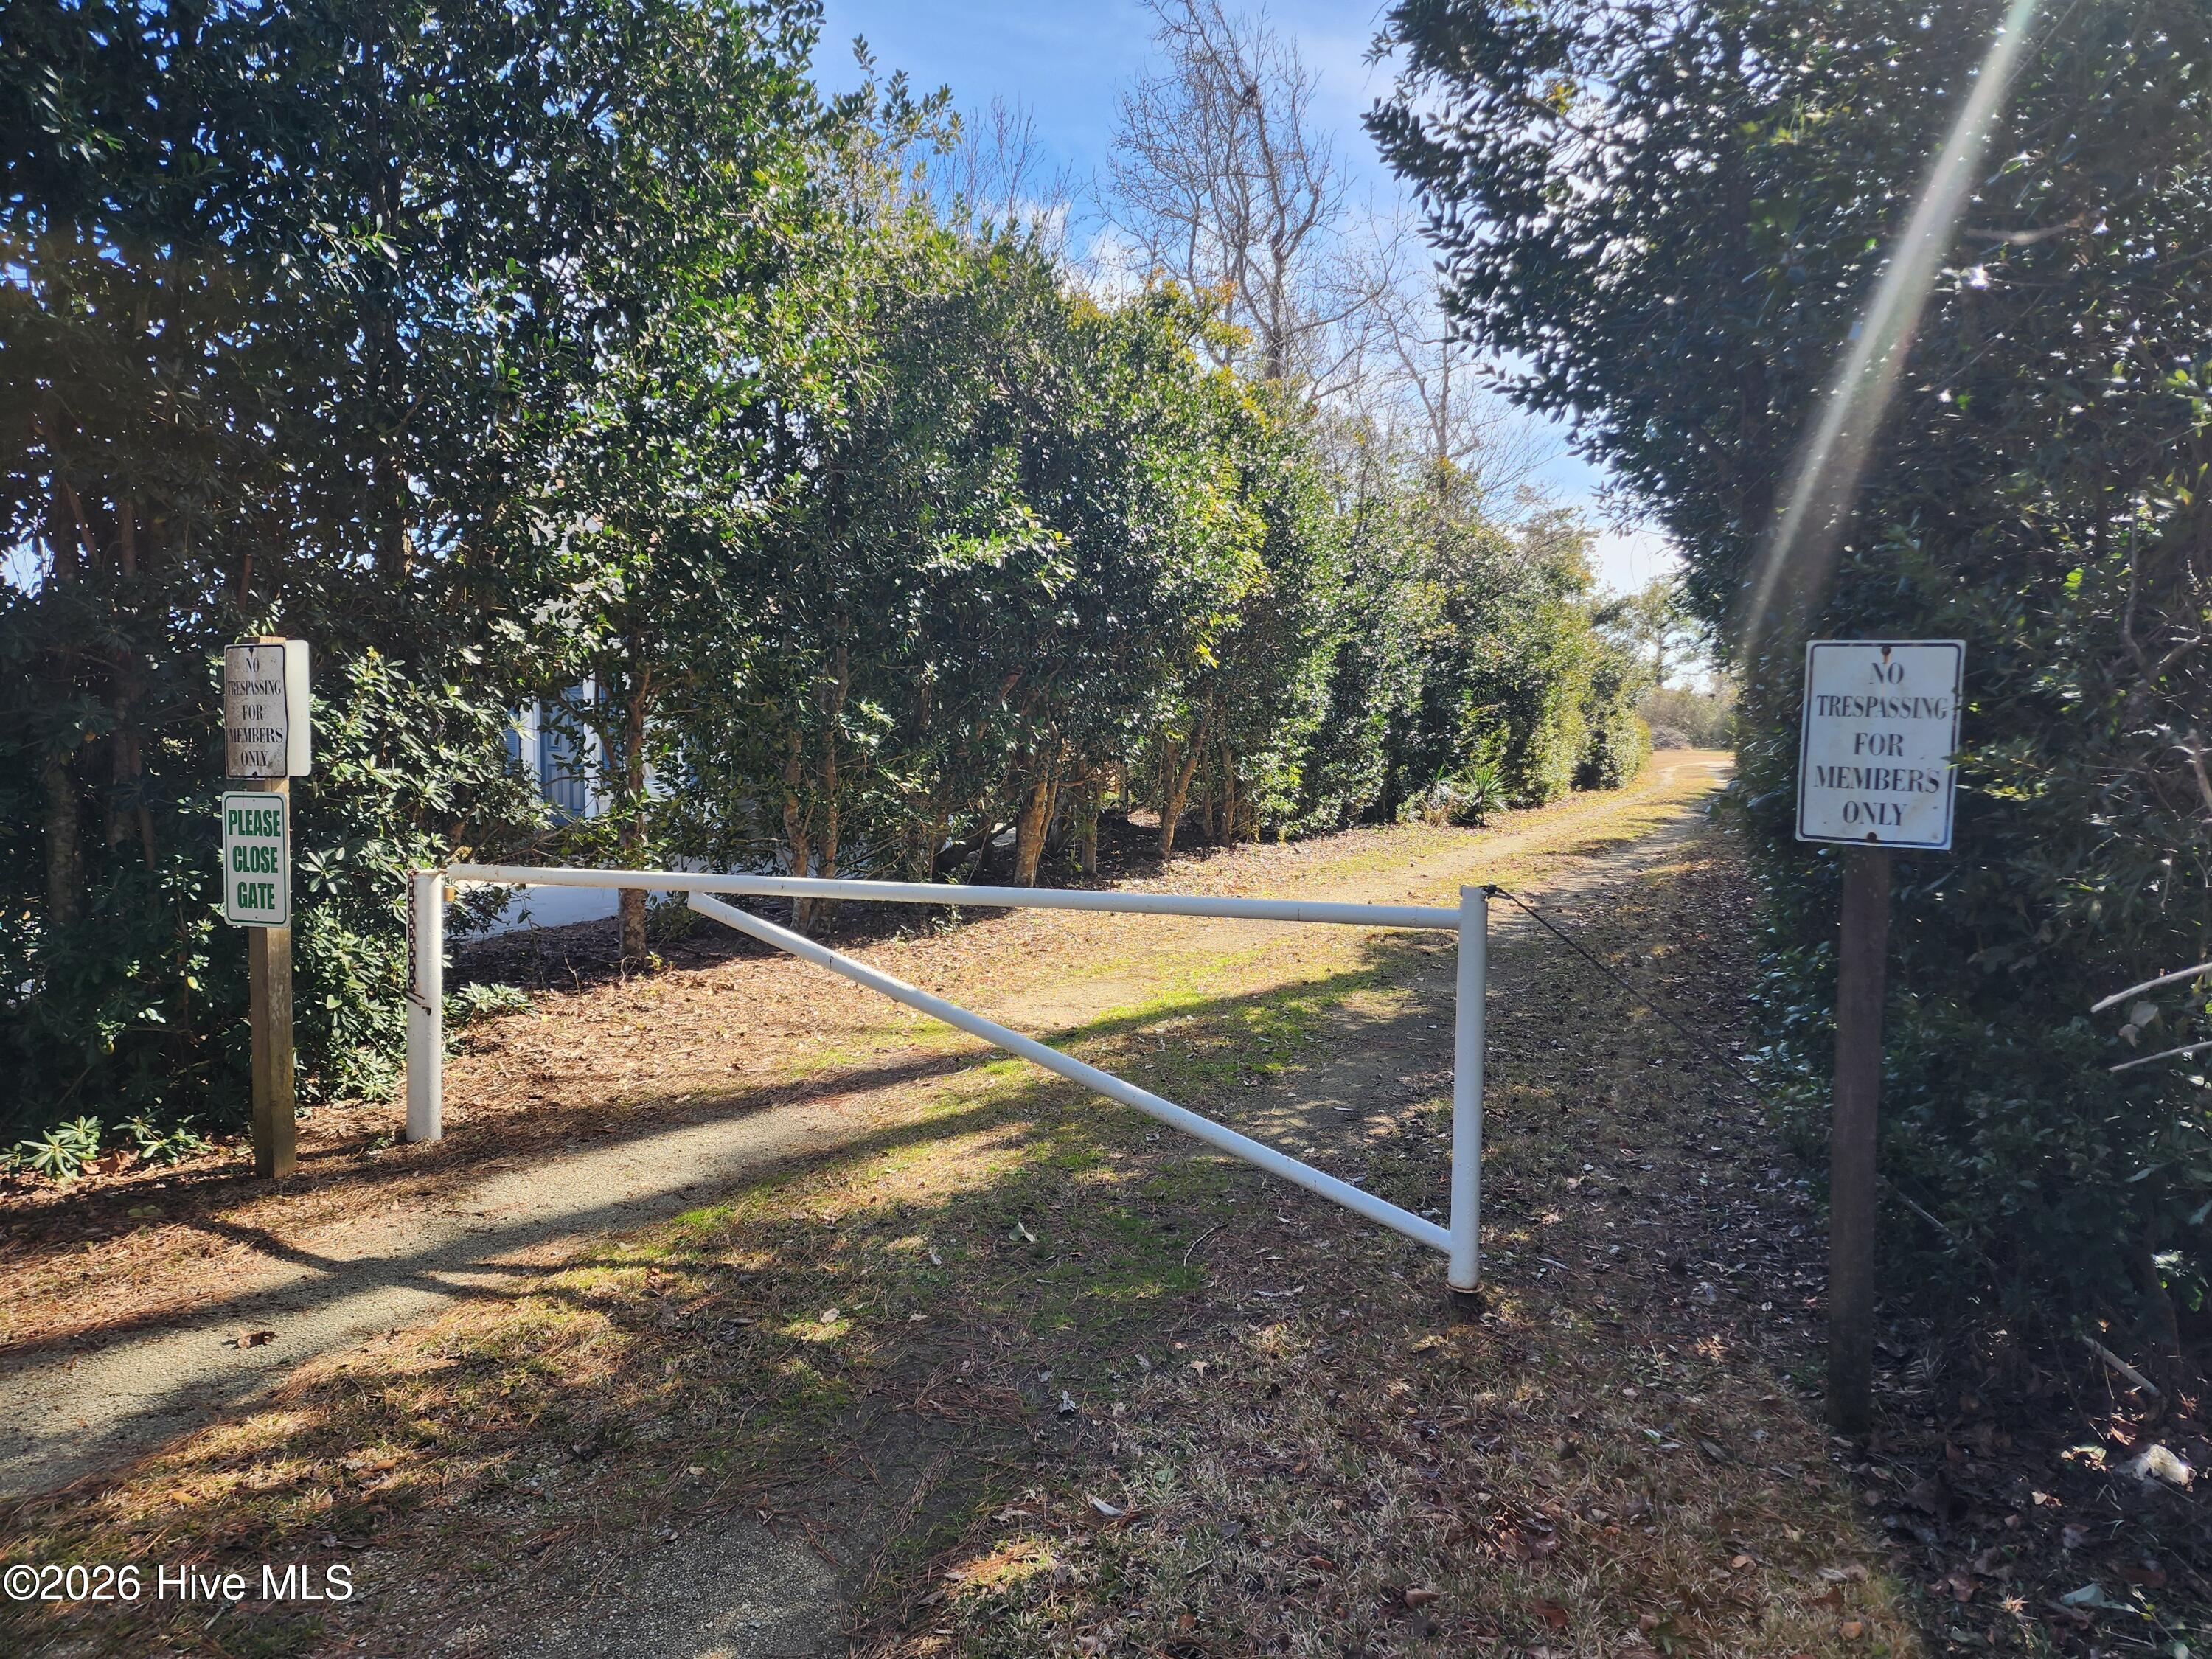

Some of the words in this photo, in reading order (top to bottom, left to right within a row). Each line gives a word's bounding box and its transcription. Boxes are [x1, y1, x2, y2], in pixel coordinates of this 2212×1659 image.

[246, 658, 260, 672] NO
[1868, 661, 1905, 684] NO
[228, 680, 281, 695] TRESPASSING
[242, 705, 264, 720] FOR
[1817, 695, 1948, 720] TRESPASSING
[229, 728, 283, 743] MEMBERS
[1853, 732, 1904, 757] FOR
[240, 751, 268, 766] ONLY
[1814, 765, 1940, 793] MEMBERS
[228, 810, 281, 836] PLEASE
[1843, 801, 1907, 826] ONLY
[233, 846, 278, 873] CLOSE
[237, 882, 275, 909] GATE
